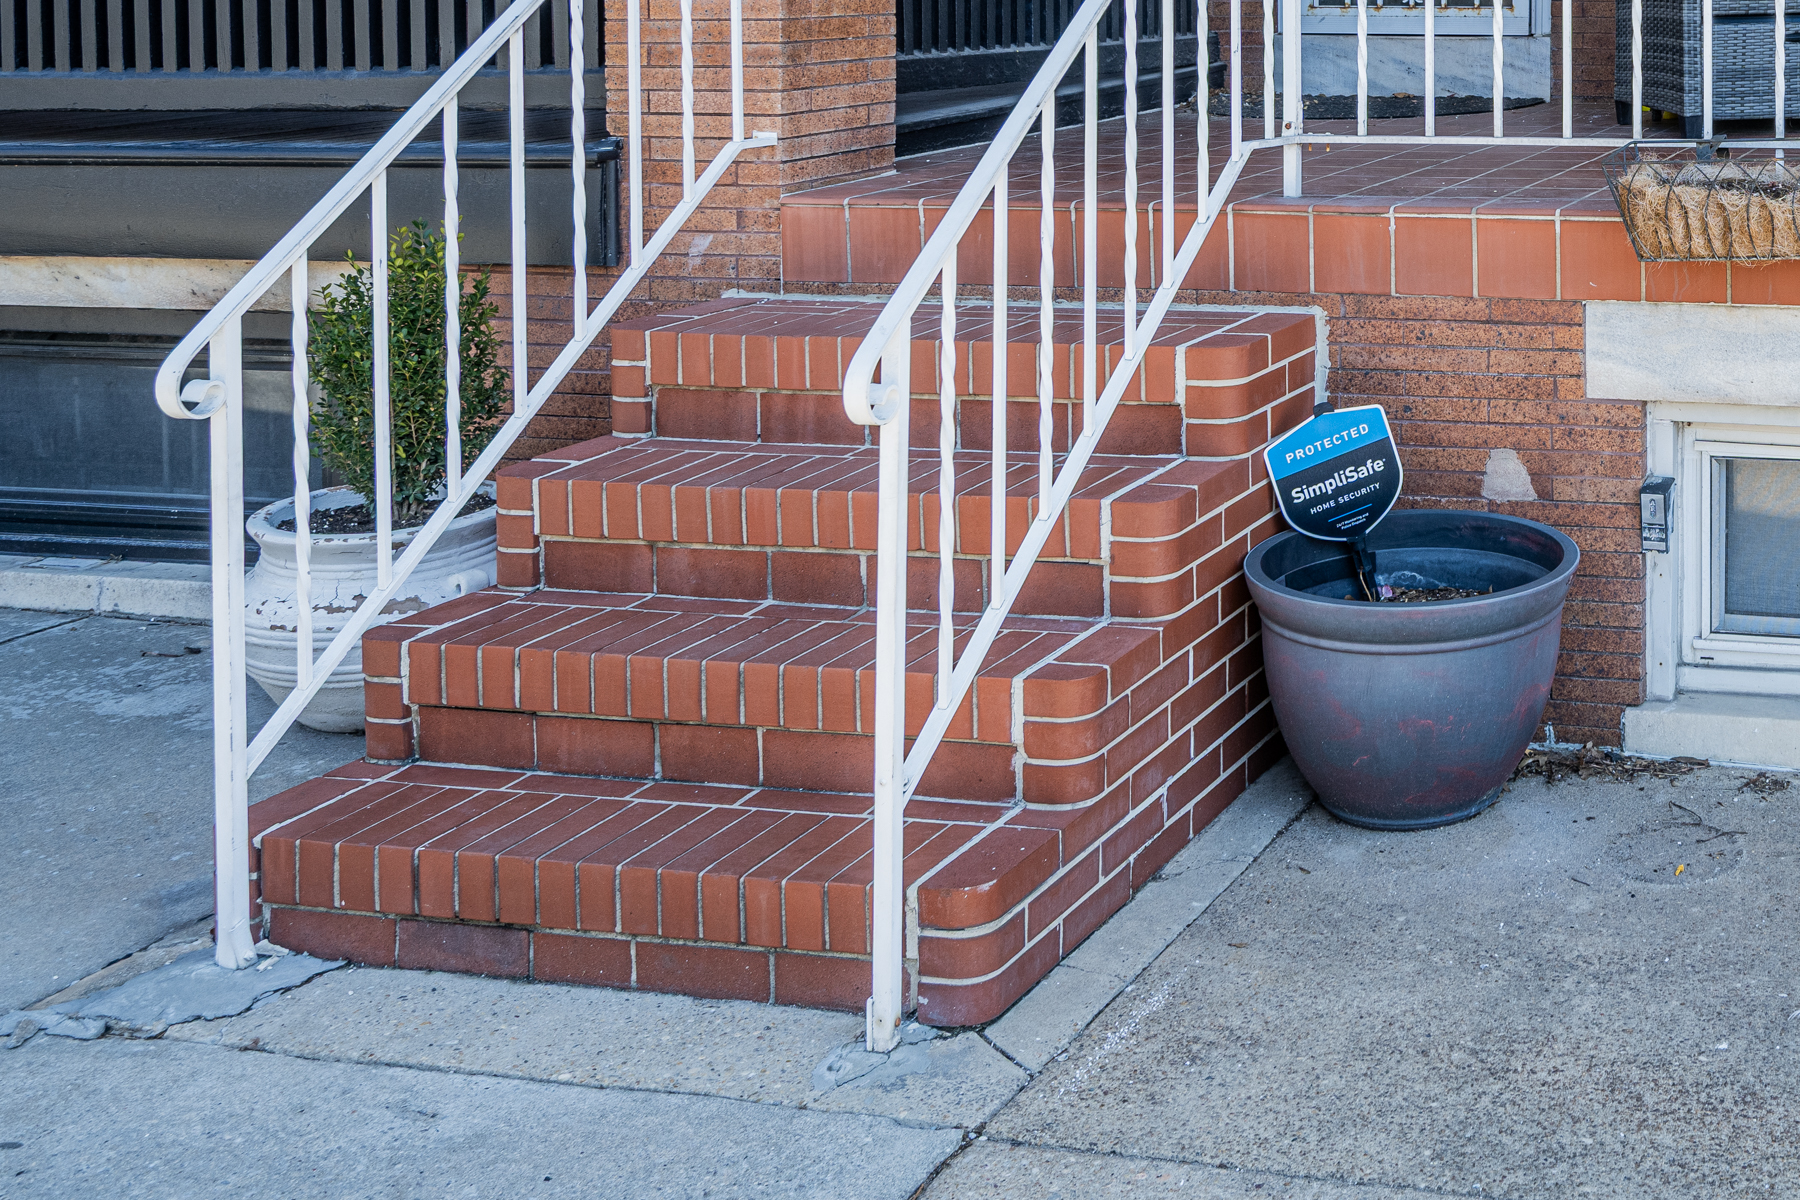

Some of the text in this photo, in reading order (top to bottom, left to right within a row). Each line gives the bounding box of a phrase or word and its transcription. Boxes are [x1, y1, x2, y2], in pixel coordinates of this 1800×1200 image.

[1285, 423, 1369, 464] PROTECTED
[1291, 458, 1385, 504] SimpliSafe
[1310, 482, 1381, 515] HOME SECURITY
